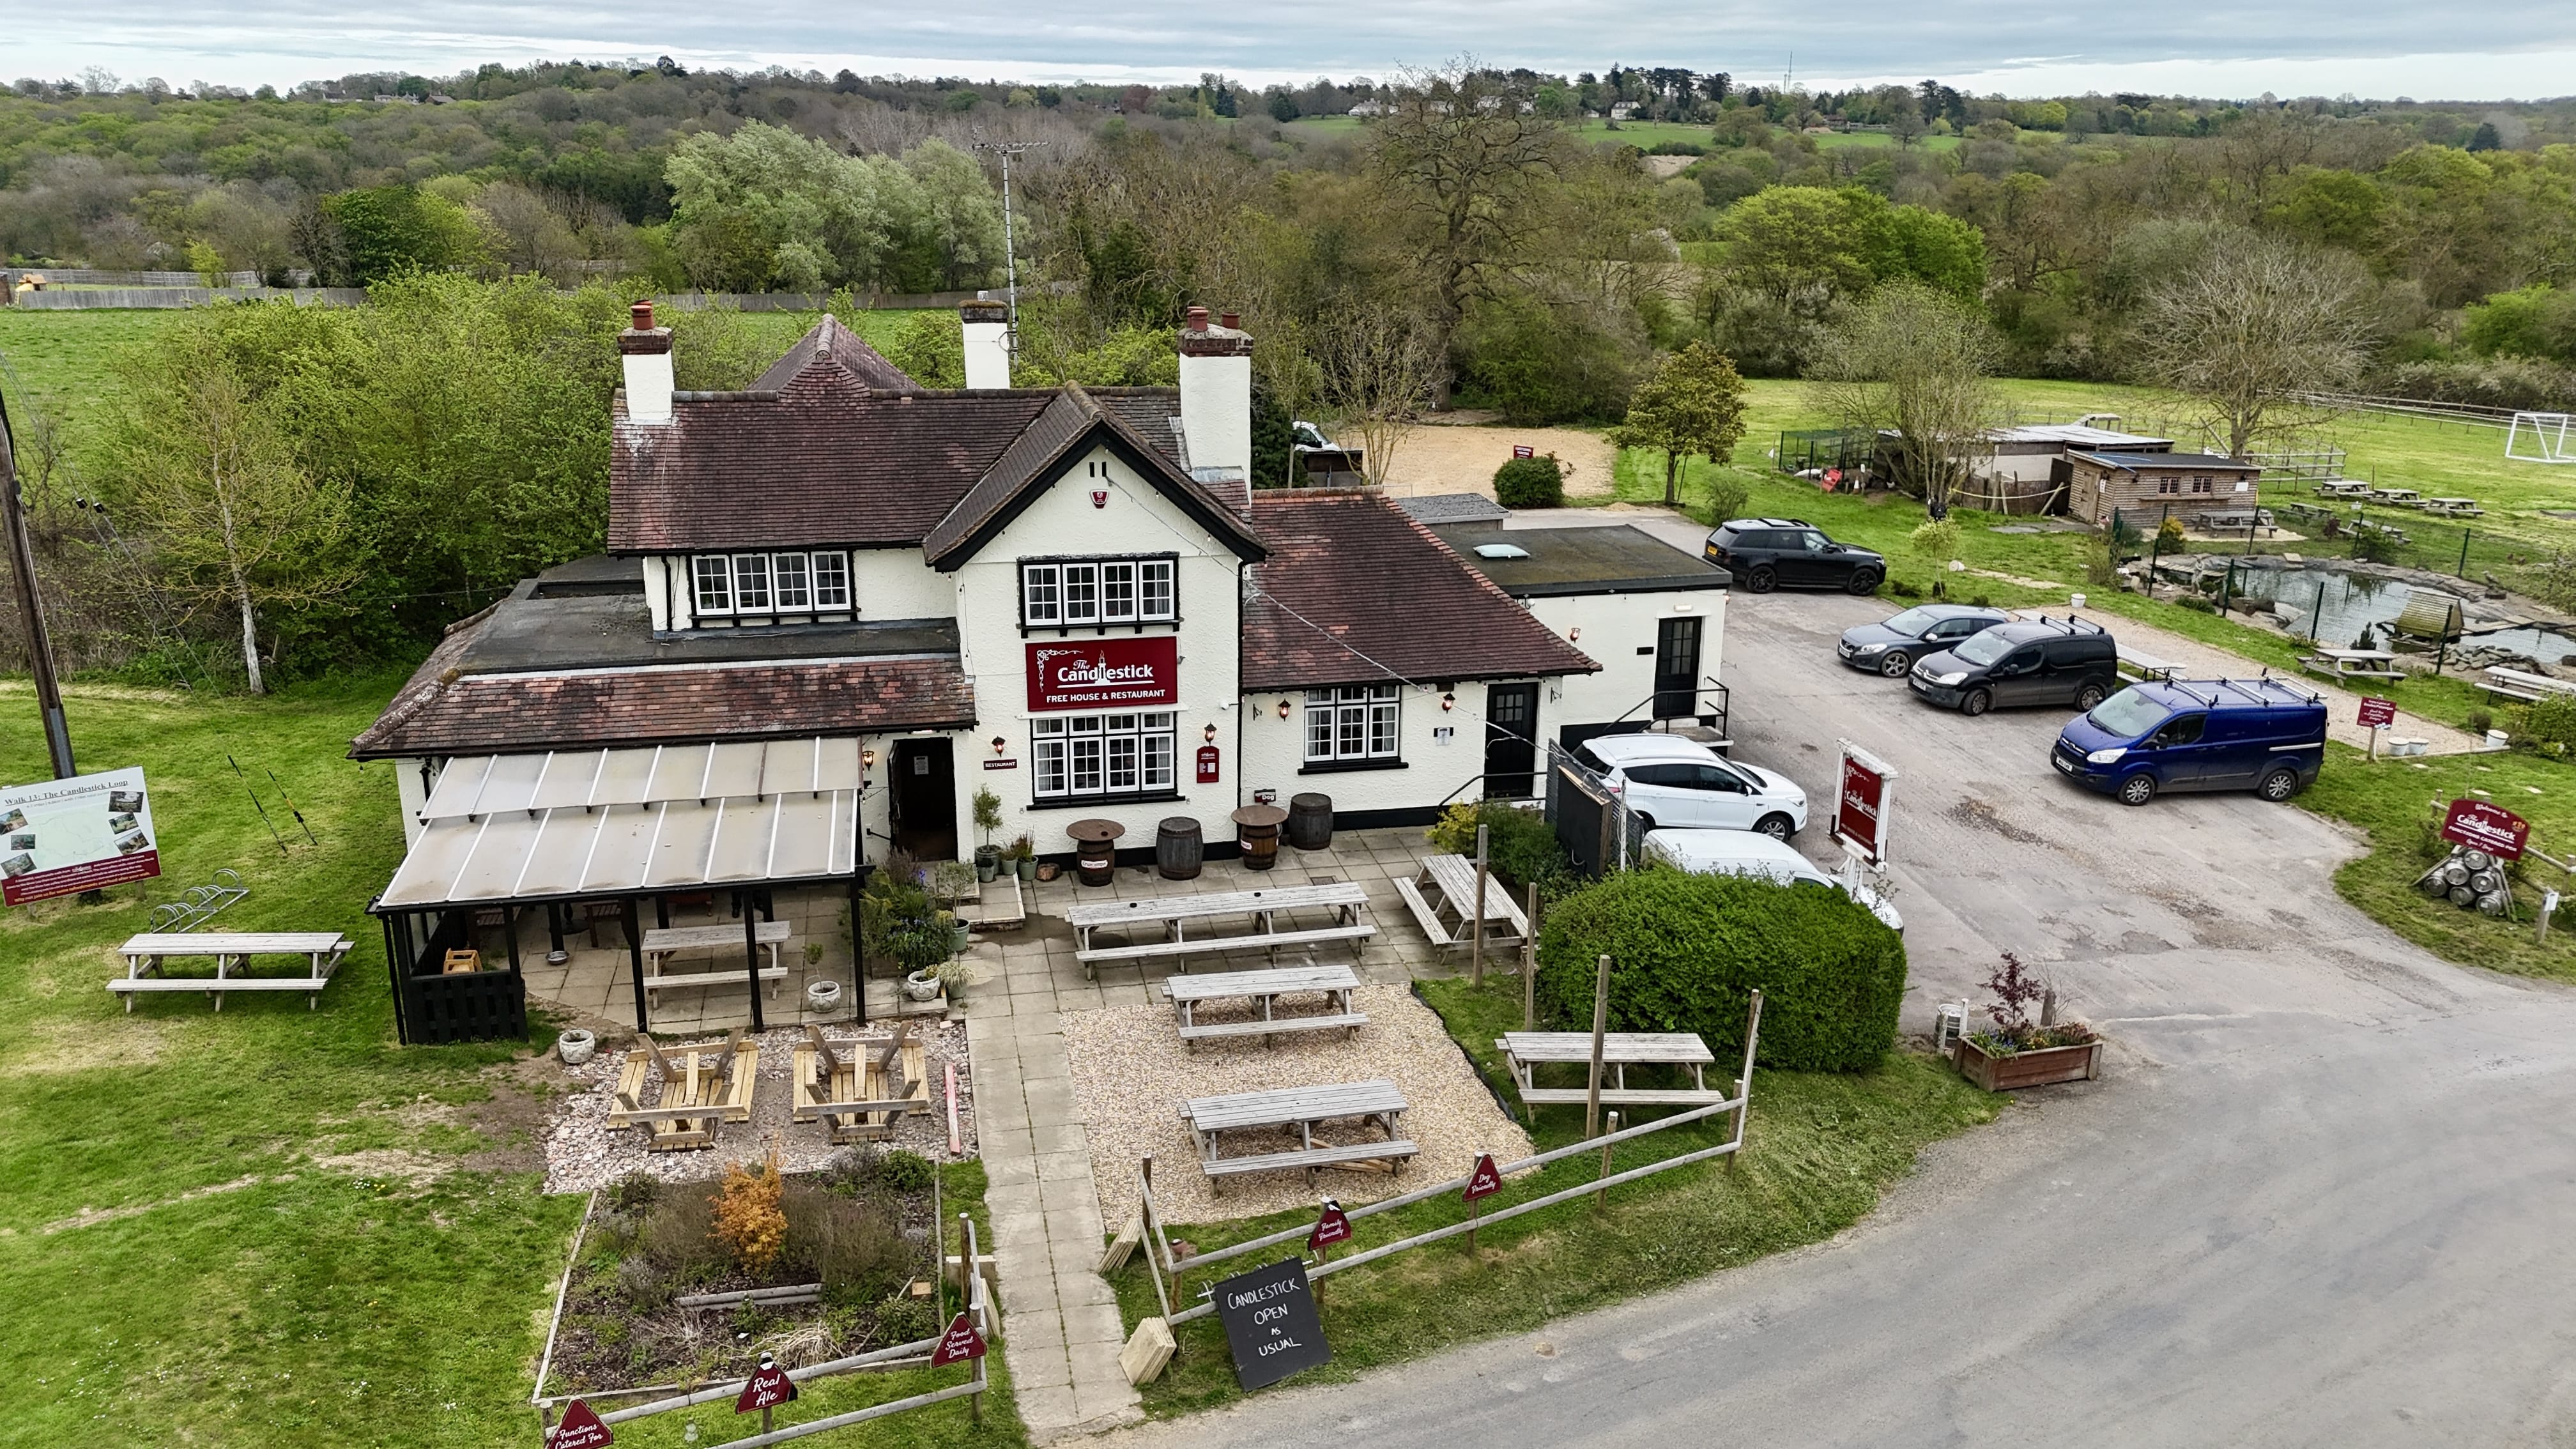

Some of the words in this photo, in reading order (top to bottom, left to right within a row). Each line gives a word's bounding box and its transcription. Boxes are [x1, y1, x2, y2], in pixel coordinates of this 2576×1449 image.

[1057, 663, 1154, 682] Candlestick
[1073, 659, 1091, 670] The
[1046, 694, 1068, 703] FREE
[1070, 693, 1100, 702] HOUSE
[1111, 689, 1165, 700] RESTAURANT
[4, 796, 26, 804] Walk
[60, 784, 105, 796] Candlestick
[108, 779, 128, 788] Loop
[1846, 791, 1876, 817] Candlestick
[2474, 804, 2501, 815] Welcome
[2457, 815, 2516, 840] Candlestick
[1471, 1181, 1496, 1194] Friendly
[1321, 1218, 1342, 1231] Family
[1227, 1277, 1301, 1310] CANDLESTICK
[1254, 1303, 1288, 1324] OPEN
[950, 1328, 970, 1340] Food
[1271, 1326, 1282, 1335] AS
[946, 1336, 974, 1350] Served
[1259, 1337, 1302, 1356] USUAL
[948, 1346, 969, 1358] Daily
[753, 1374, 780, 1393] Real
[755, 1390, 778, 1406] Ale
[559, 1423, 599, 1440] Functions
[555, 1436, 586, 1449] Catered
[588, 1432, 604, 1444] For
